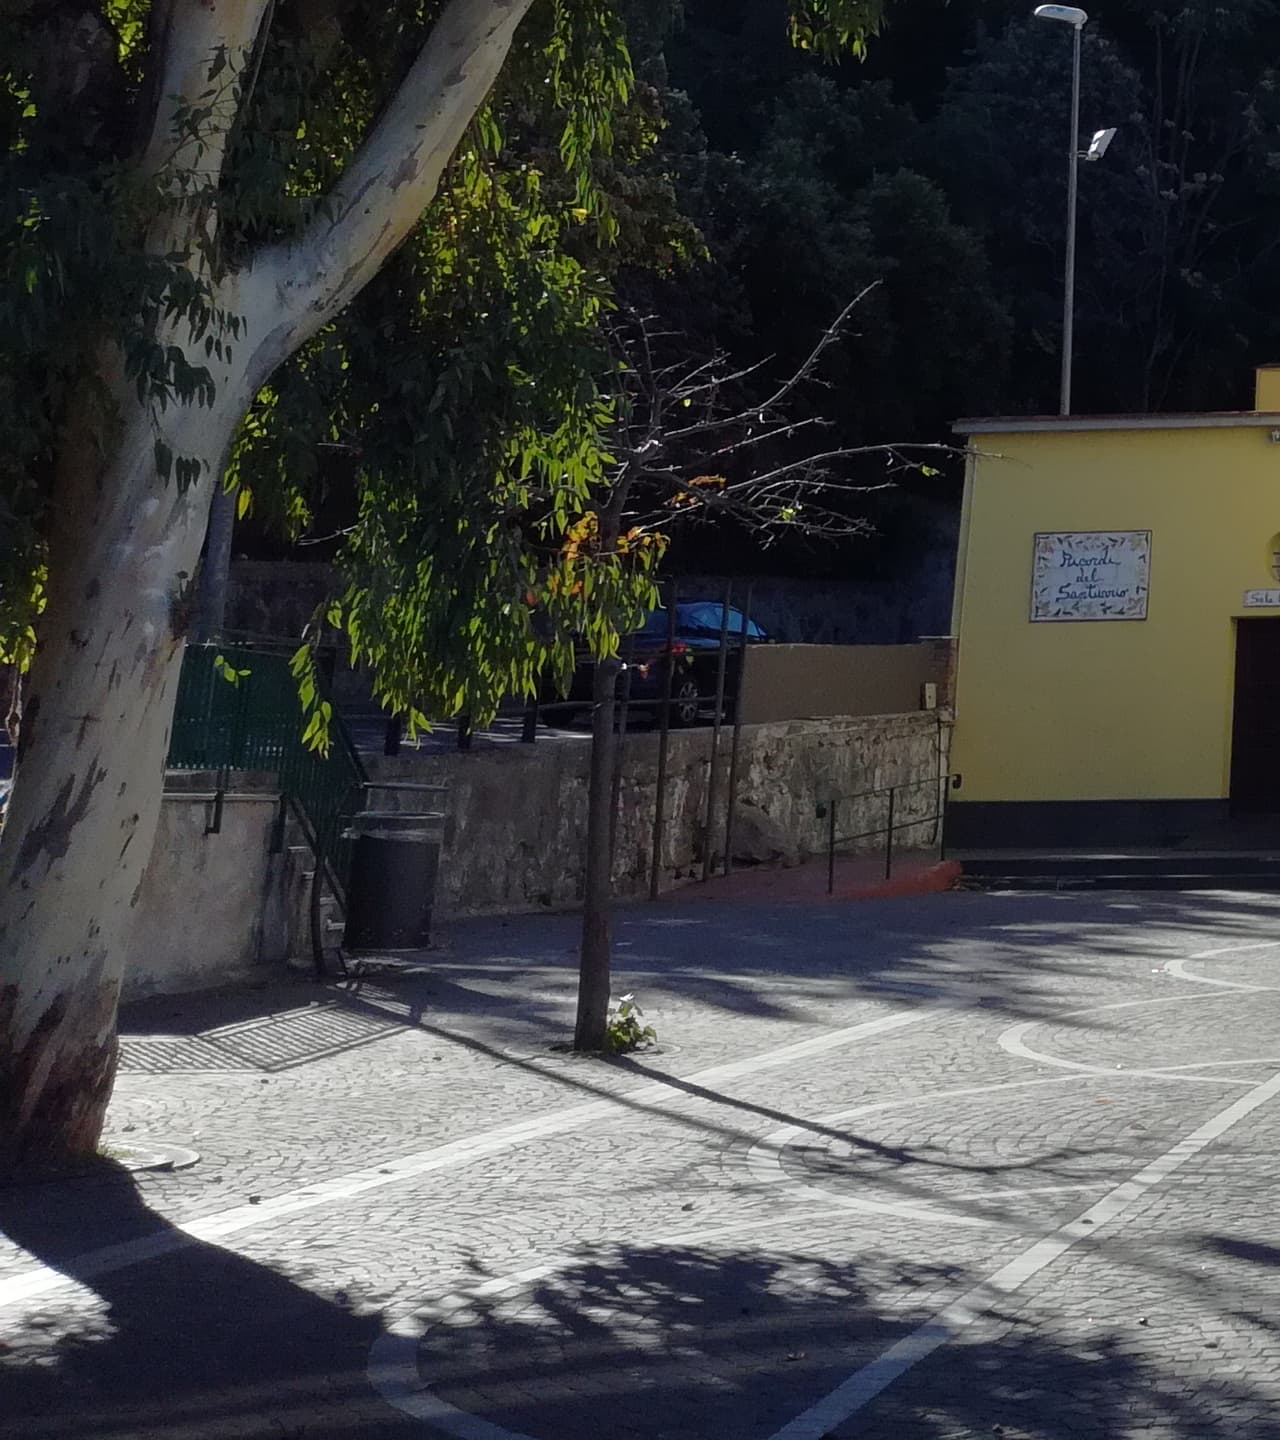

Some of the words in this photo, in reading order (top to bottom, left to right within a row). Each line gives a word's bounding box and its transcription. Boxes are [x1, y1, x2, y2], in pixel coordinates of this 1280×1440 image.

[1059, 545, 1121, 567] Ricordi
[1076, 567, 1104, 583] del
[1055, 583, 1129, 603] Santuario
